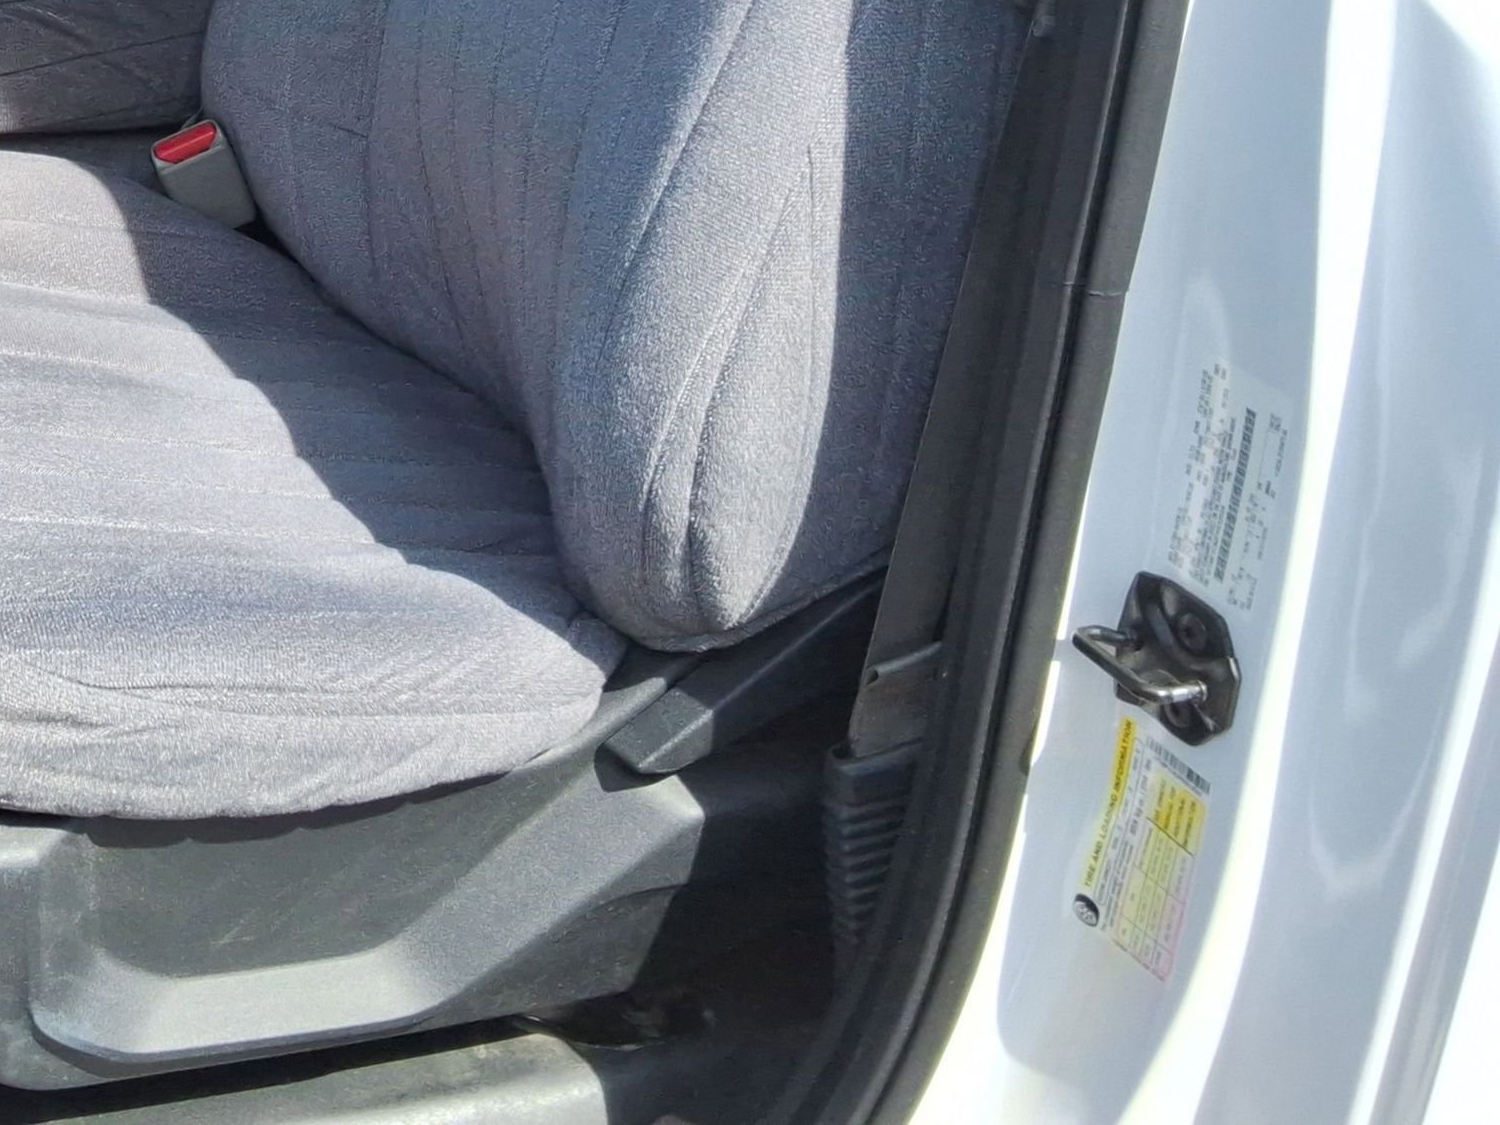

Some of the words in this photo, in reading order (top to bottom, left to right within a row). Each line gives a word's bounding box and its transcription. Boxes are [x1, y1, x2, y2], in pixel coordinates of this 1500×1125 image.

[1085, 867, 1097, 888] TIRE
[1091, 840, 1102, 865] AND
[1113, 719, 1132, 792] INFORMATION
